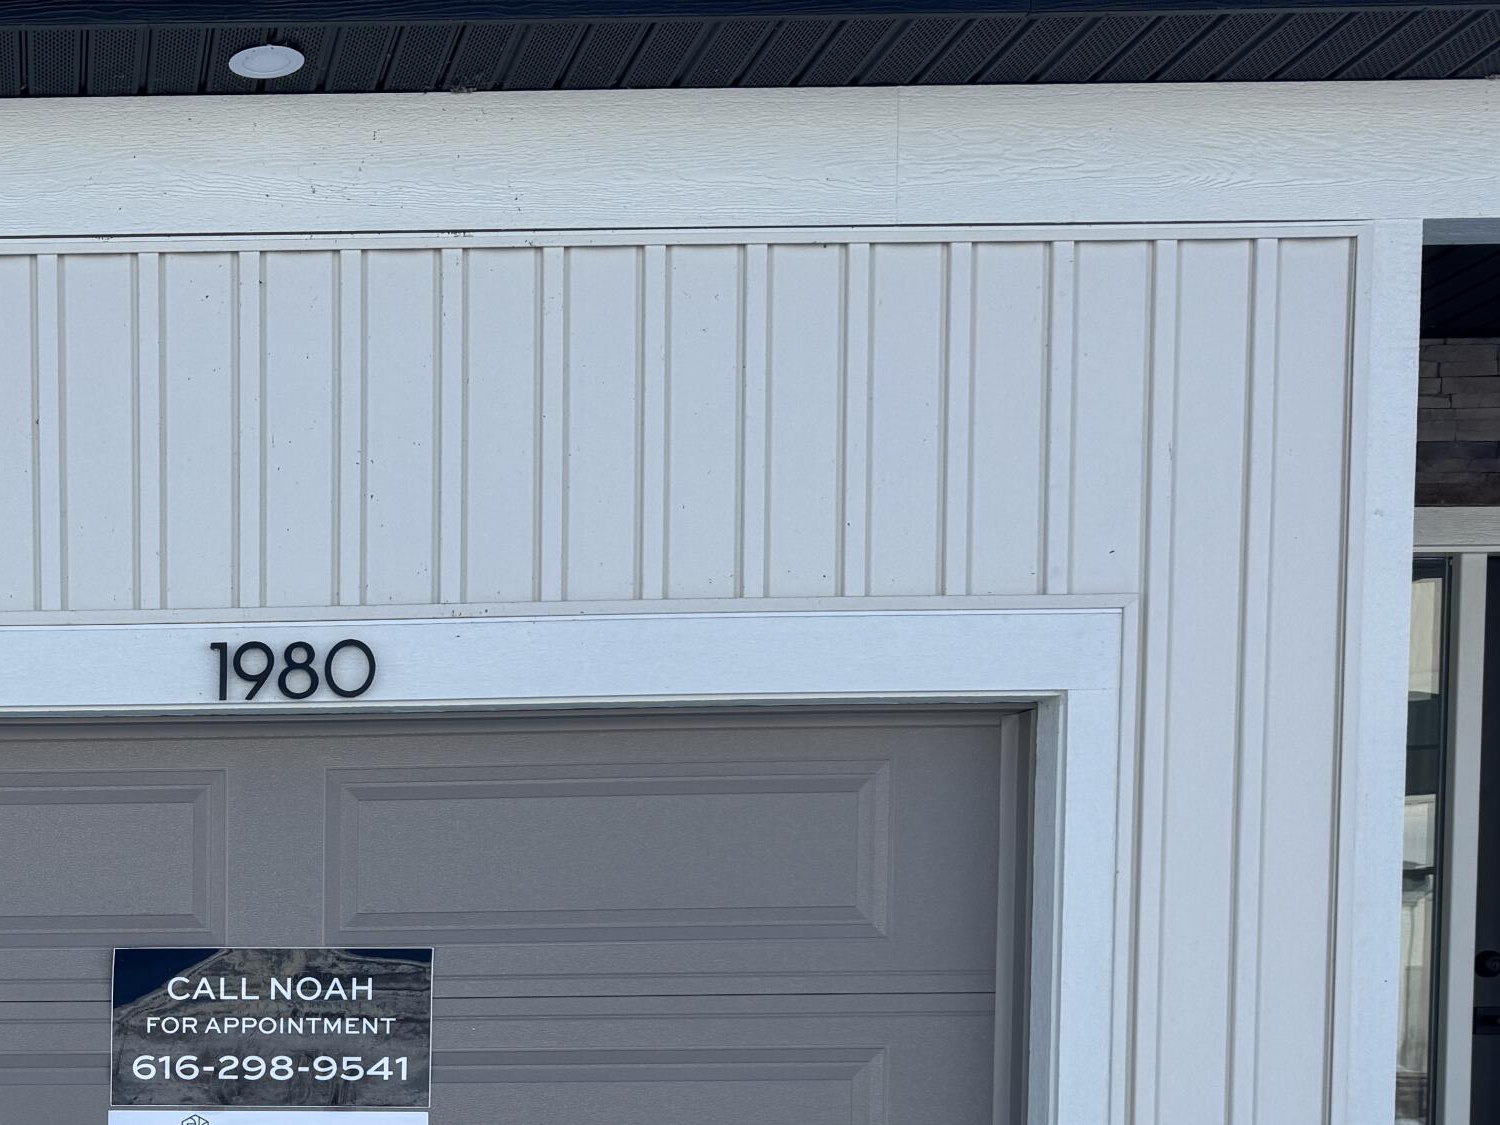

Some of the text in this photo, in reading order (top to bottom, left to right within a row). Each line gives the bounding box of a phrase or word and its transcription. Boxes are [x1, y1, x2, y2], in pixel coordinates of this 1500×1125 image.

[210, 639, 376, 700] 1980
[167, 976, 373, 1001] CALL NOAH
[146, 1016, 396, 1035] FOR APPOINTMENT
[132, 1055, 408, 1081] 616-298-9541
